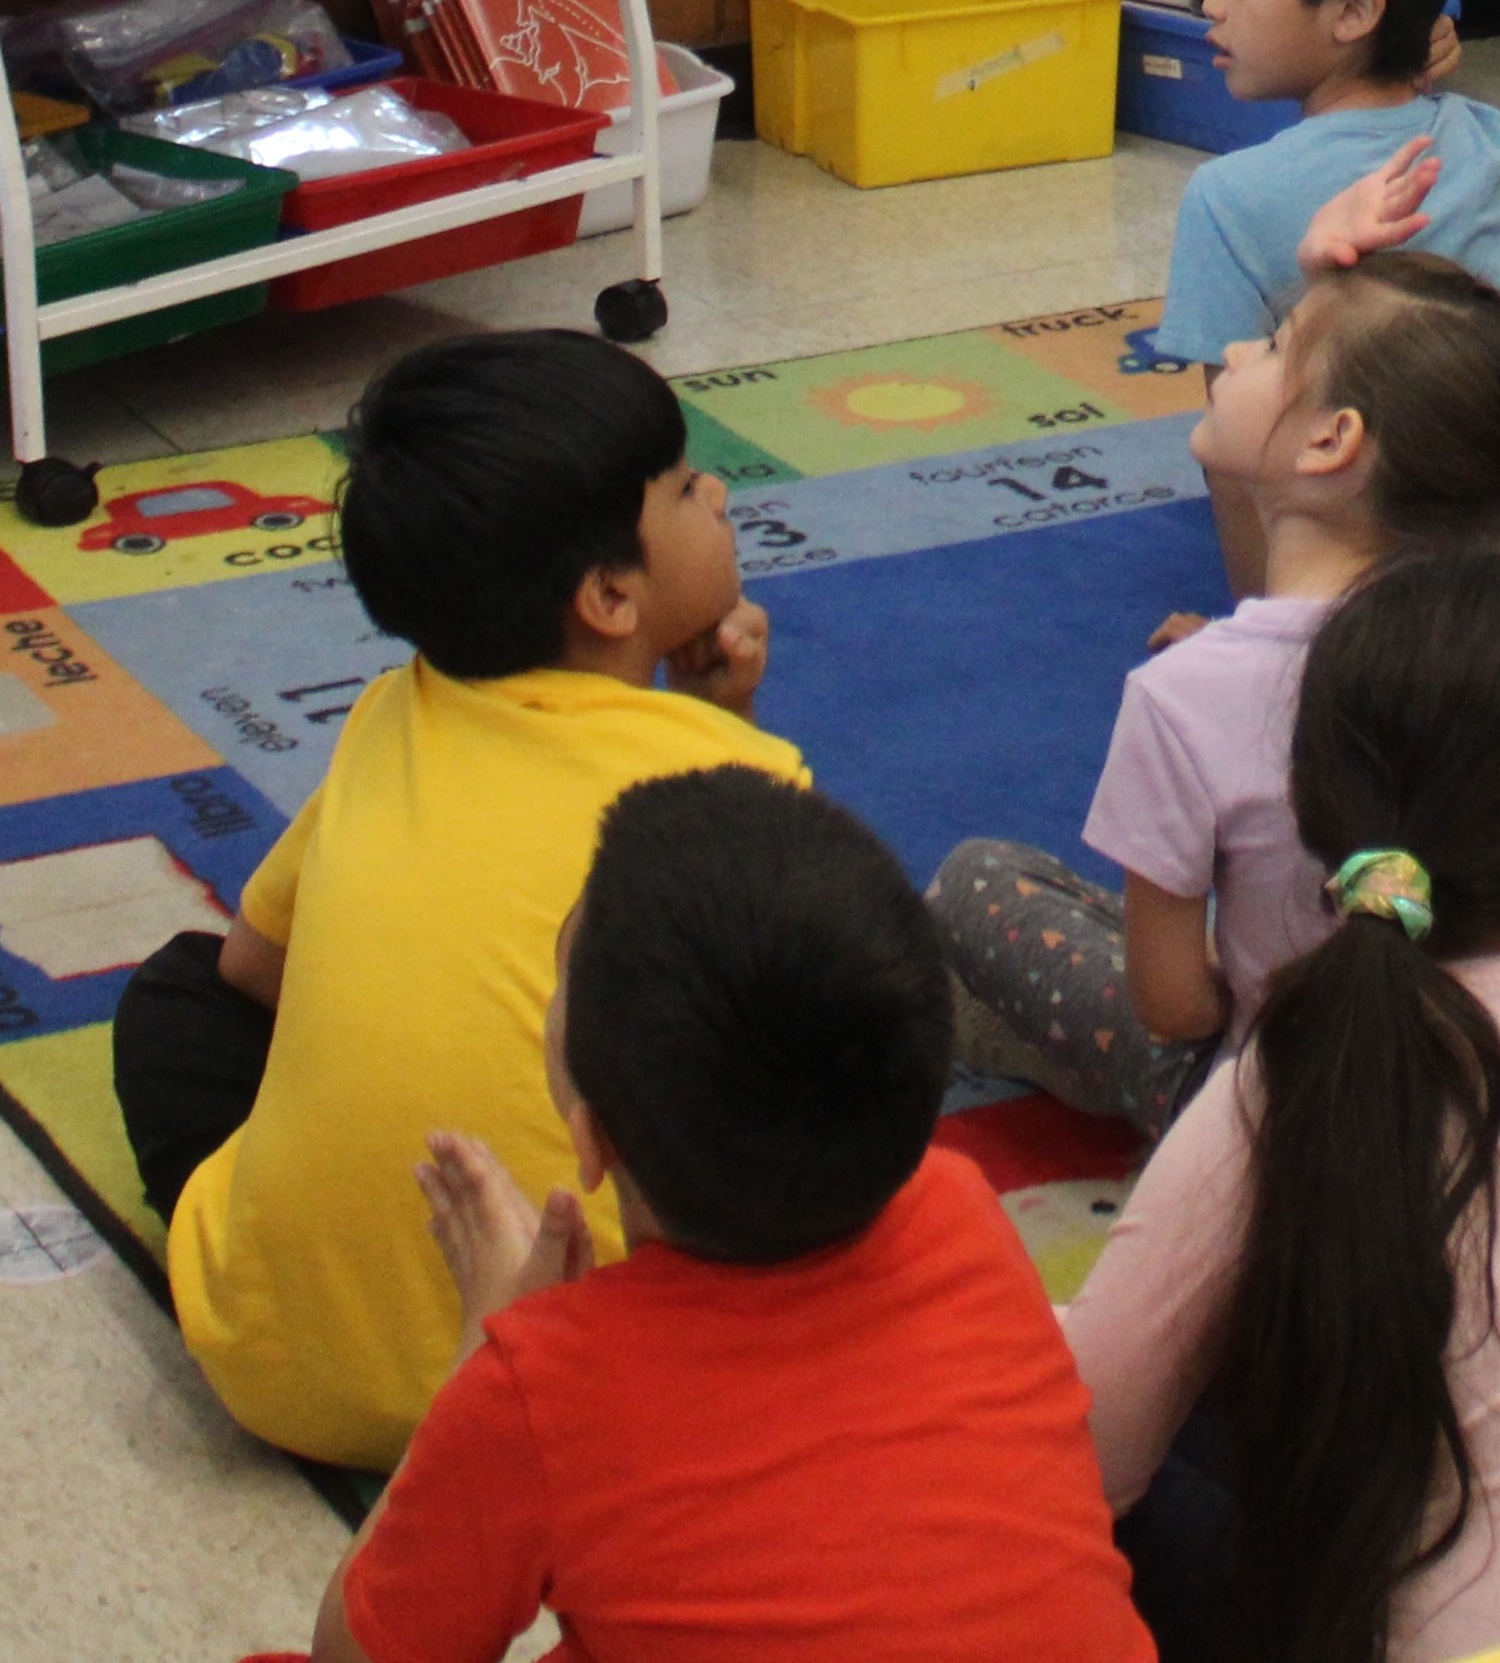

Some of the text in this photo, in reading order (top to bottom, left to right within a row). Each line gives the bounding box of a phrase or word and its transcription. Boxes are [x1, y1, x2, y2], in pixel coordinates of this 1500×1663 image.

[1000, 303, 1140, 338] truck
[683, 365, 780, 393] sun
[1028, 402, 1105, 429] sol
[986, 464, 1110, 504] 14
[993, 481, 1176, 529] catorce
[3, 619, 101, 687] leche
[200, 684, 298, 755] eleven
